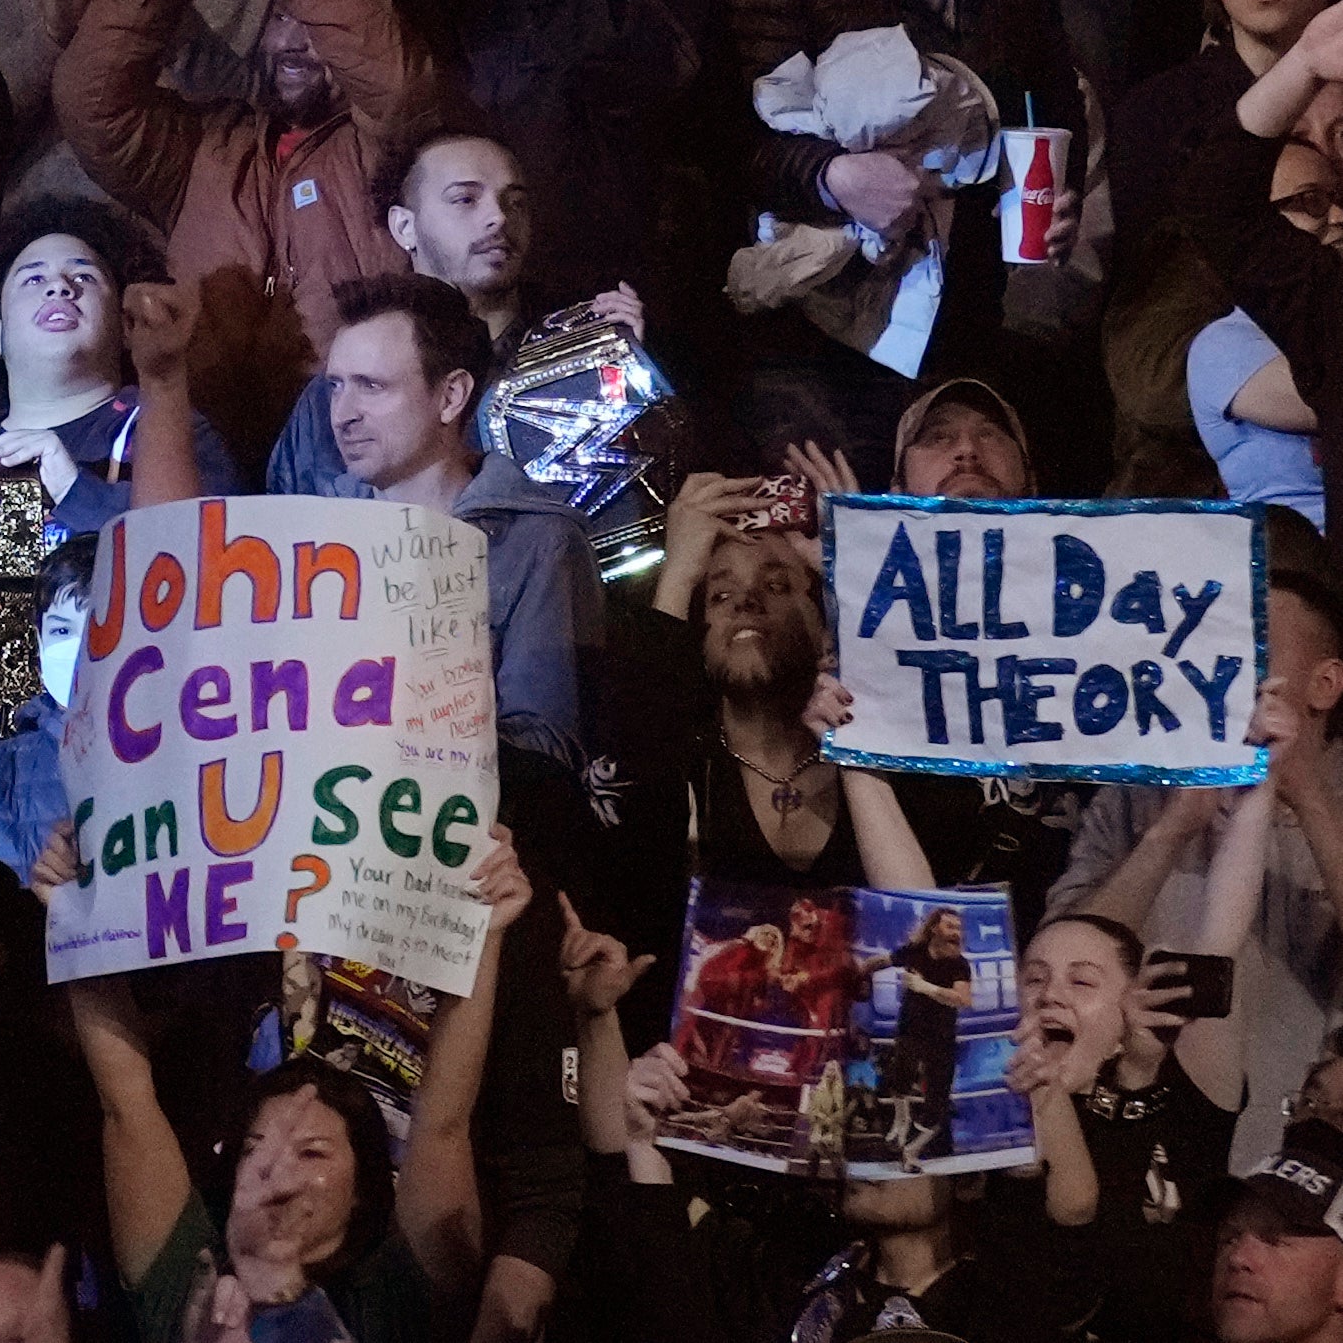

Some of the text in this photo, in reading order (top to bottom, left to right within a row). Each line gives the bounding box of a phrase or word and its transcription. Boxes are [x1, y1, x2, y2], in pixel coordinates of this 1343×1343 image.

[400, 507, 419, 532] I
[86, 499, 361, 662] John
[383, 564, 477, 610] be just
[857, 520, 1225, 659] ALL Day
[408, 614, 458, 647] like
[107, 644, 397, 764] Cena
[896, 649, 1243, 747] THEORY
[198, 750, 284, 857] U
[349, 856, 394, 885] Your
